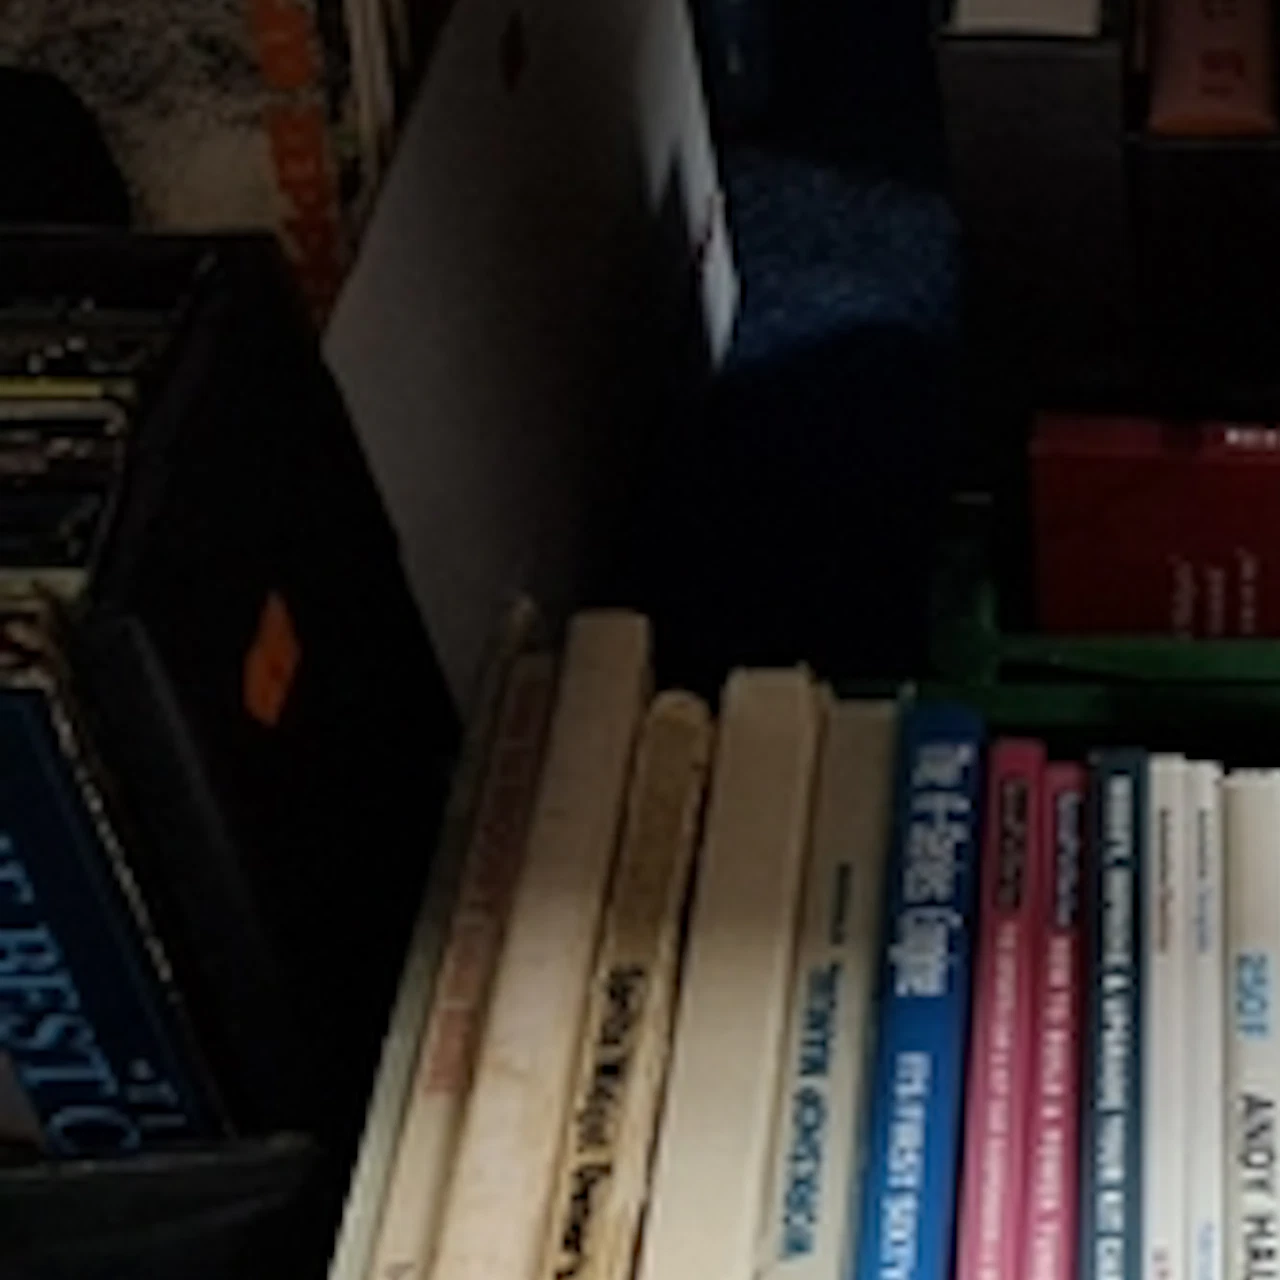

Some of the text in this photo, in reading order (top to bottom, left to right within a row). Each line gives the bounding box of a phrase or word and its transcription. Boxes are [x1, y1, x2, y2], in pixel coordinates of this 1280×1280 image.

[1234, 952, 1271, 1041] 250F
[883, 1098, 930, 1190] FIRST
[1238, 1092, 1276, 1194] ANDY
[1096, 1188, 1126, 1232] KIT
